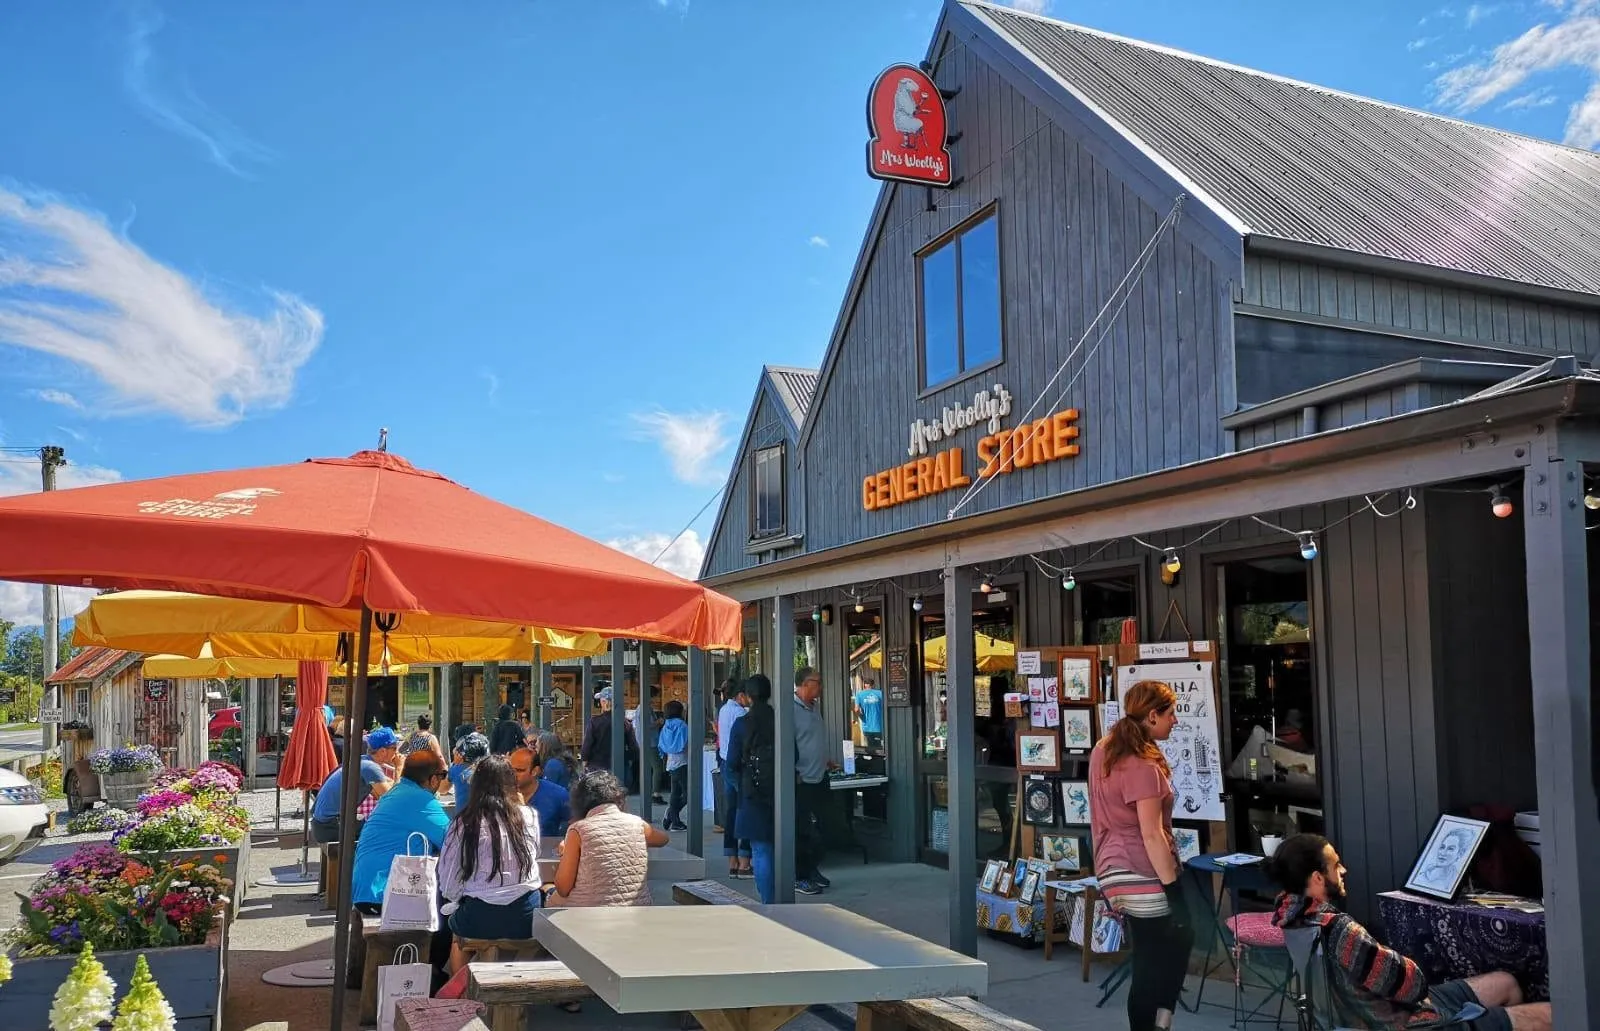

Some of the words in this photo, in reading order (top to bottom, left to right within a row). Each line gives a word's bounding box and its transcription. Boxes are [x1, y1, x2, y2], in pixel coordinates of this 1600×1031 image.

[880, 149, 903, 166] Mrs
[904, 152, 944, 176] Woolly's
[908, 419, 943, 456] Mrs
[943, 384, 1012, 435] Woolly's
[864, 448, 970, 510] GENERAL
[978, 409, 1079, 477] STORE
